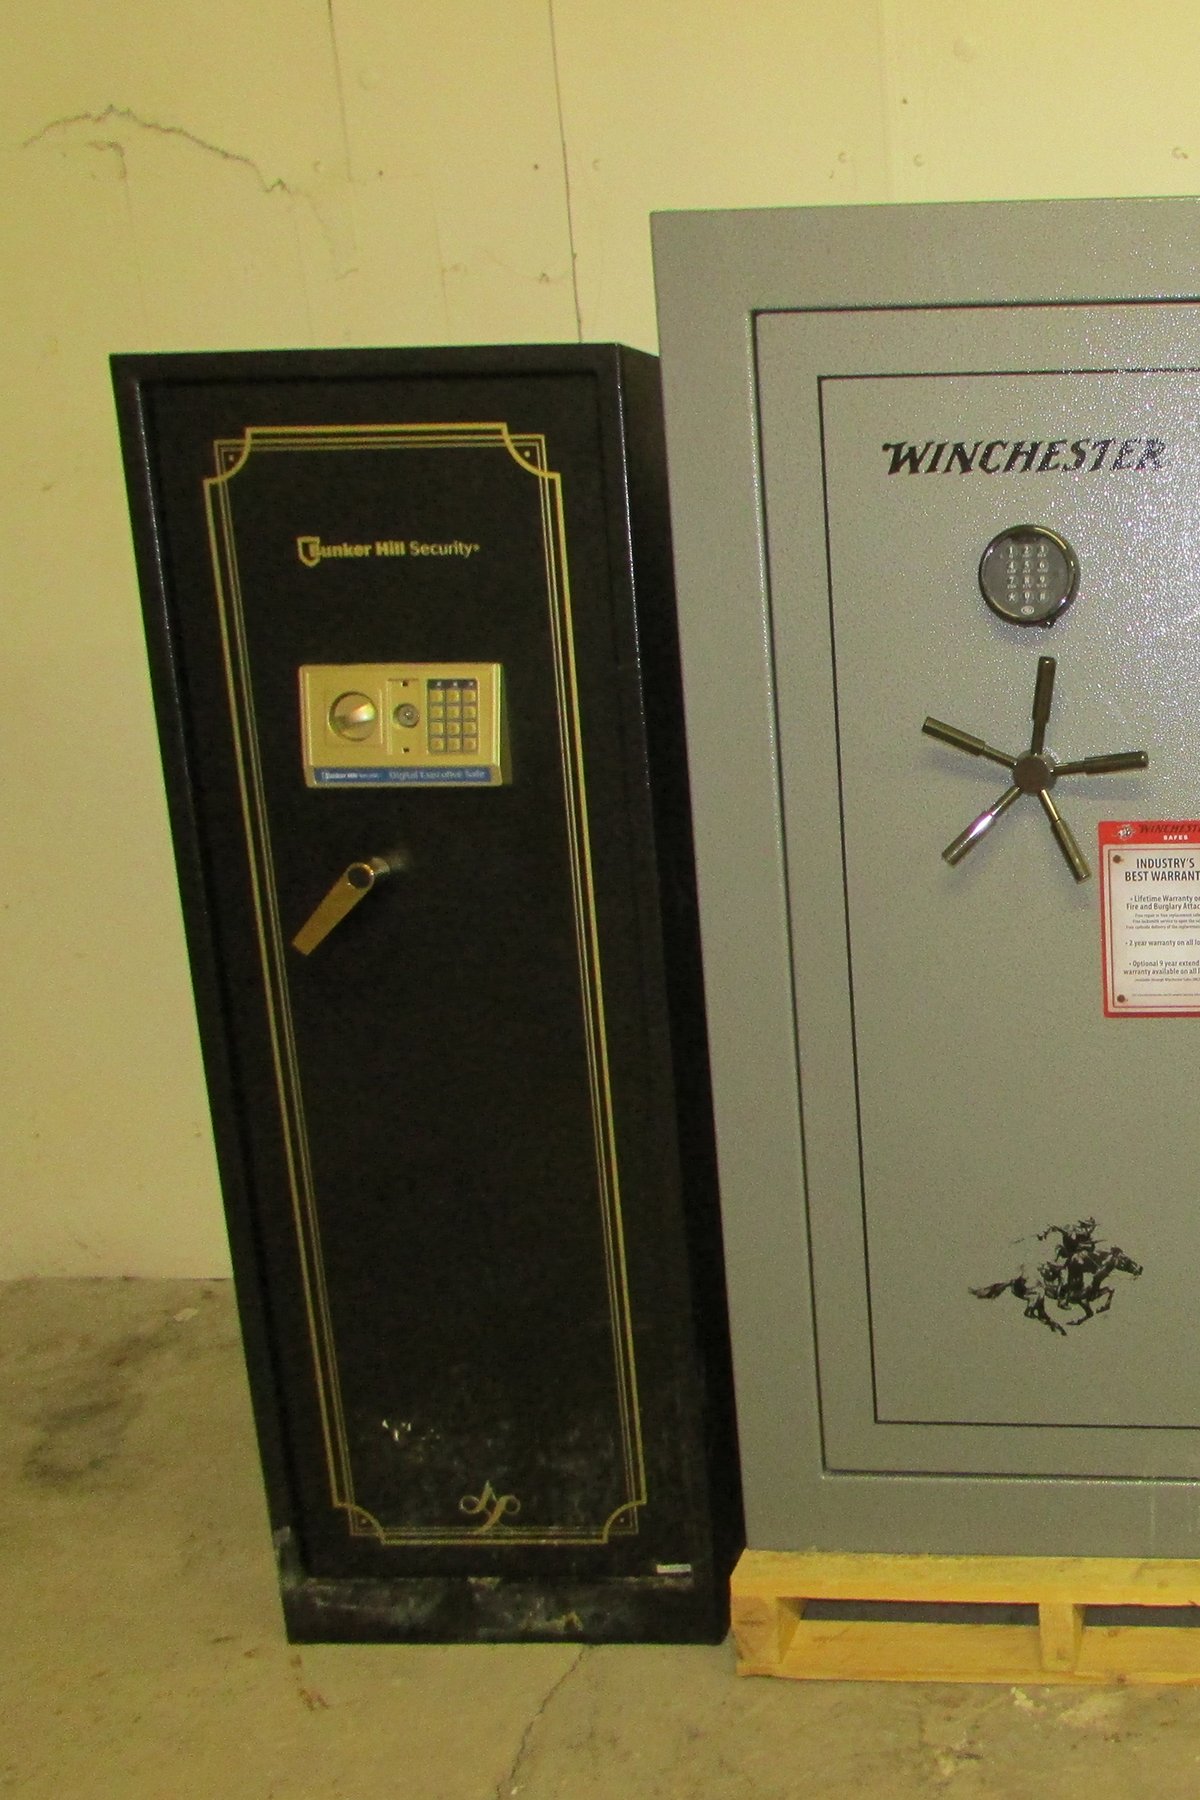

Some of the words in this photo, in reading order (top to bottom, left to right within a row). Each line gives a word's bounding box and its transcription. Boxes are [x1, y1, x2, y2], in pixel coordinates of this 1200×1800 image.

[882, 438, 1166, 475] WINCHESTER
[375, 540, 405, 557] Hill
[1136, 858, 1195, 869] INDUSTRY'S
[1125, 871, 1148, 881] BEST
[1162, 895, 1193, 904] Warranty
[1153, 903, 1181, 911] Burglary
